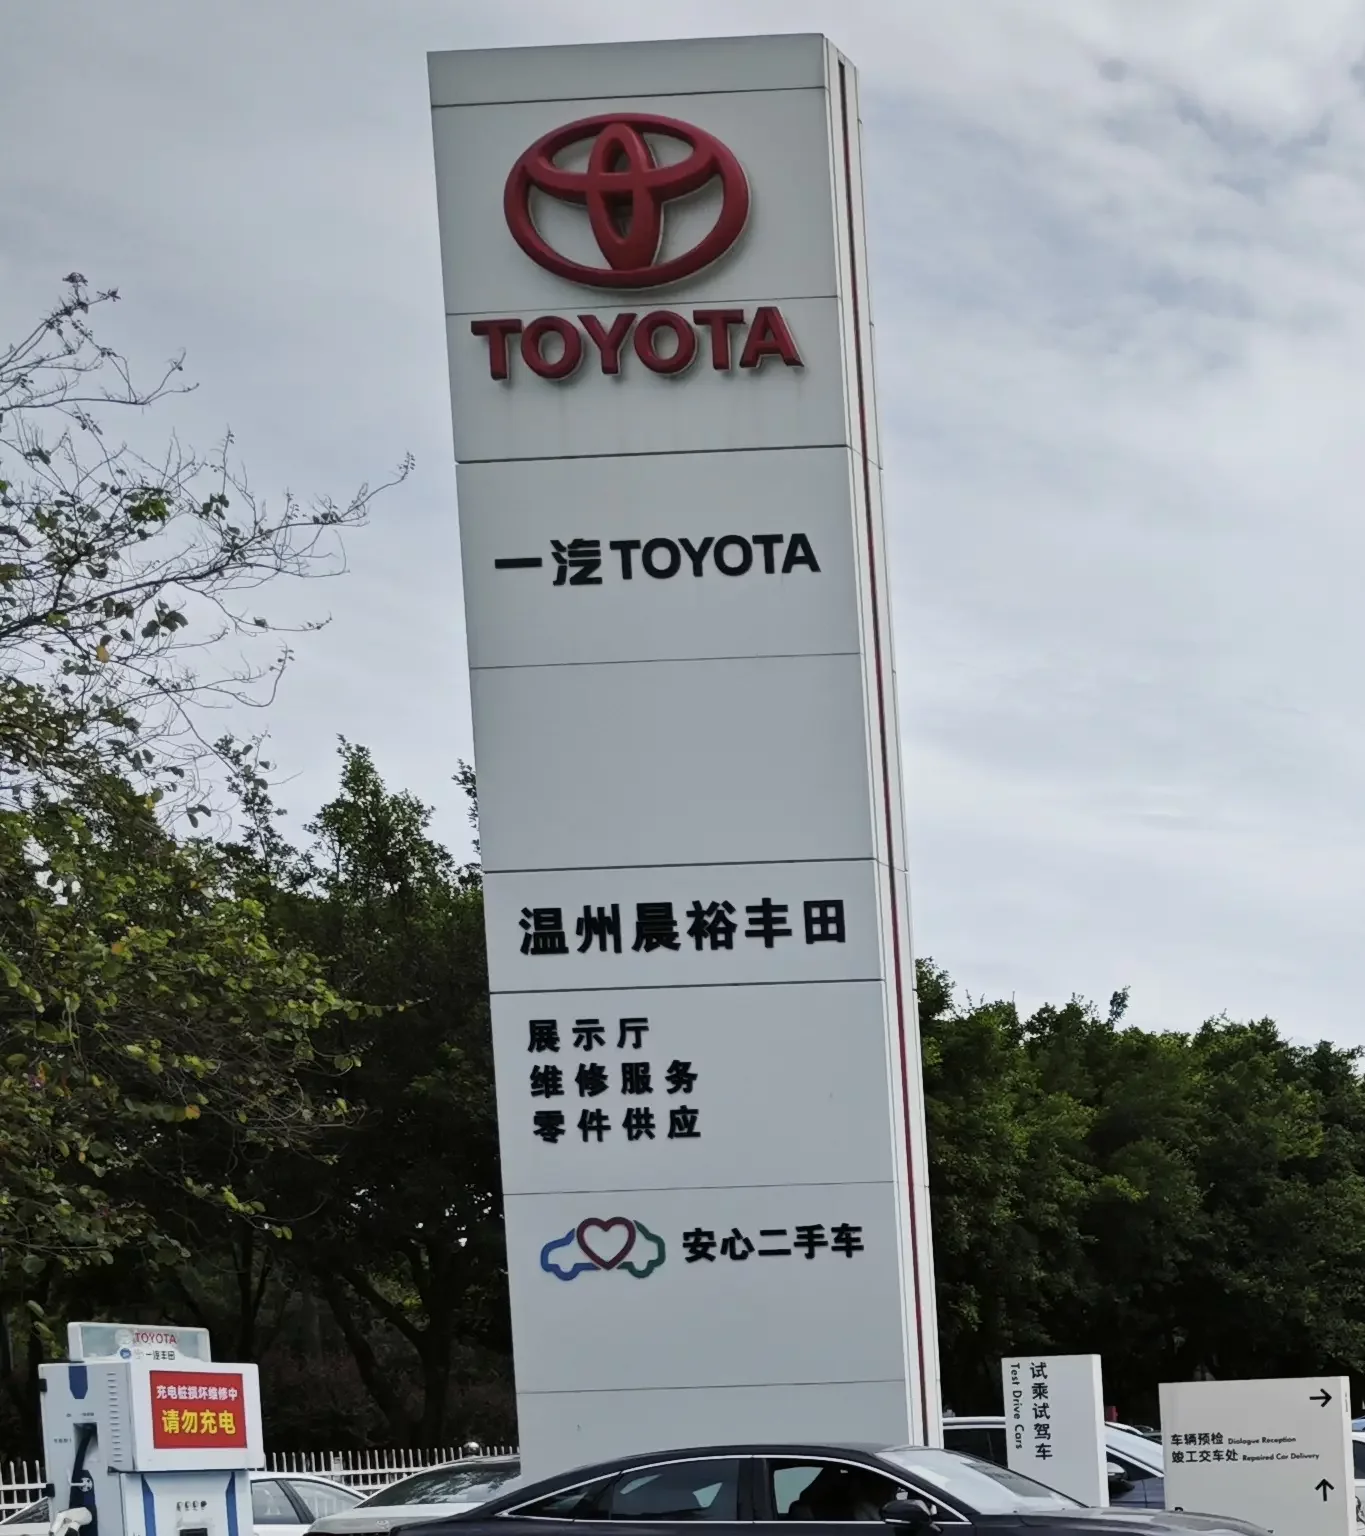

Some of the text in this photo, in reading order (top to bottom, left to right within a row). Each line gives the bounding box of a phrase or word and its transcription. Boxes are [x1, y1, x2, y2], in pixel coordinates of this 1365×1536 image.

[471, 306, 804, 381] TOYOTA
[494, 533, 821, 586] 一汽TOYOTA
[518, 898, 846, 955] 温州晨裕丰田
[527, 1017, 650, 1053] 展示厅
[530, 1060, 698, 1098] 维修服务
[533, 1105, 701, 1143] 零件供应
[682, 1223, 865, 1263] 安心二手车
[135, 1332, 177, 1345] TOYOTA
[146, 1350, 176, 1361] 一汽丰田
[156, 1385, 238, 1401] 充电桩损坏维修中
[1010, 1362, 1025, 1450] Test Drive Cars
[1029, 1361, 1053, 1461] 试乘试驾车
[161, 1409, 236, 1435] 请勿充电
[1171, 1432, 1224, 1446] 车辆预检
[1172, 1449, 1239, 1464] 竣工交车处
[1227, 1436, 1297, 1446] Dialogue Reception
[1242, 1452, 1320, 1462] Repaired Car Delivery
